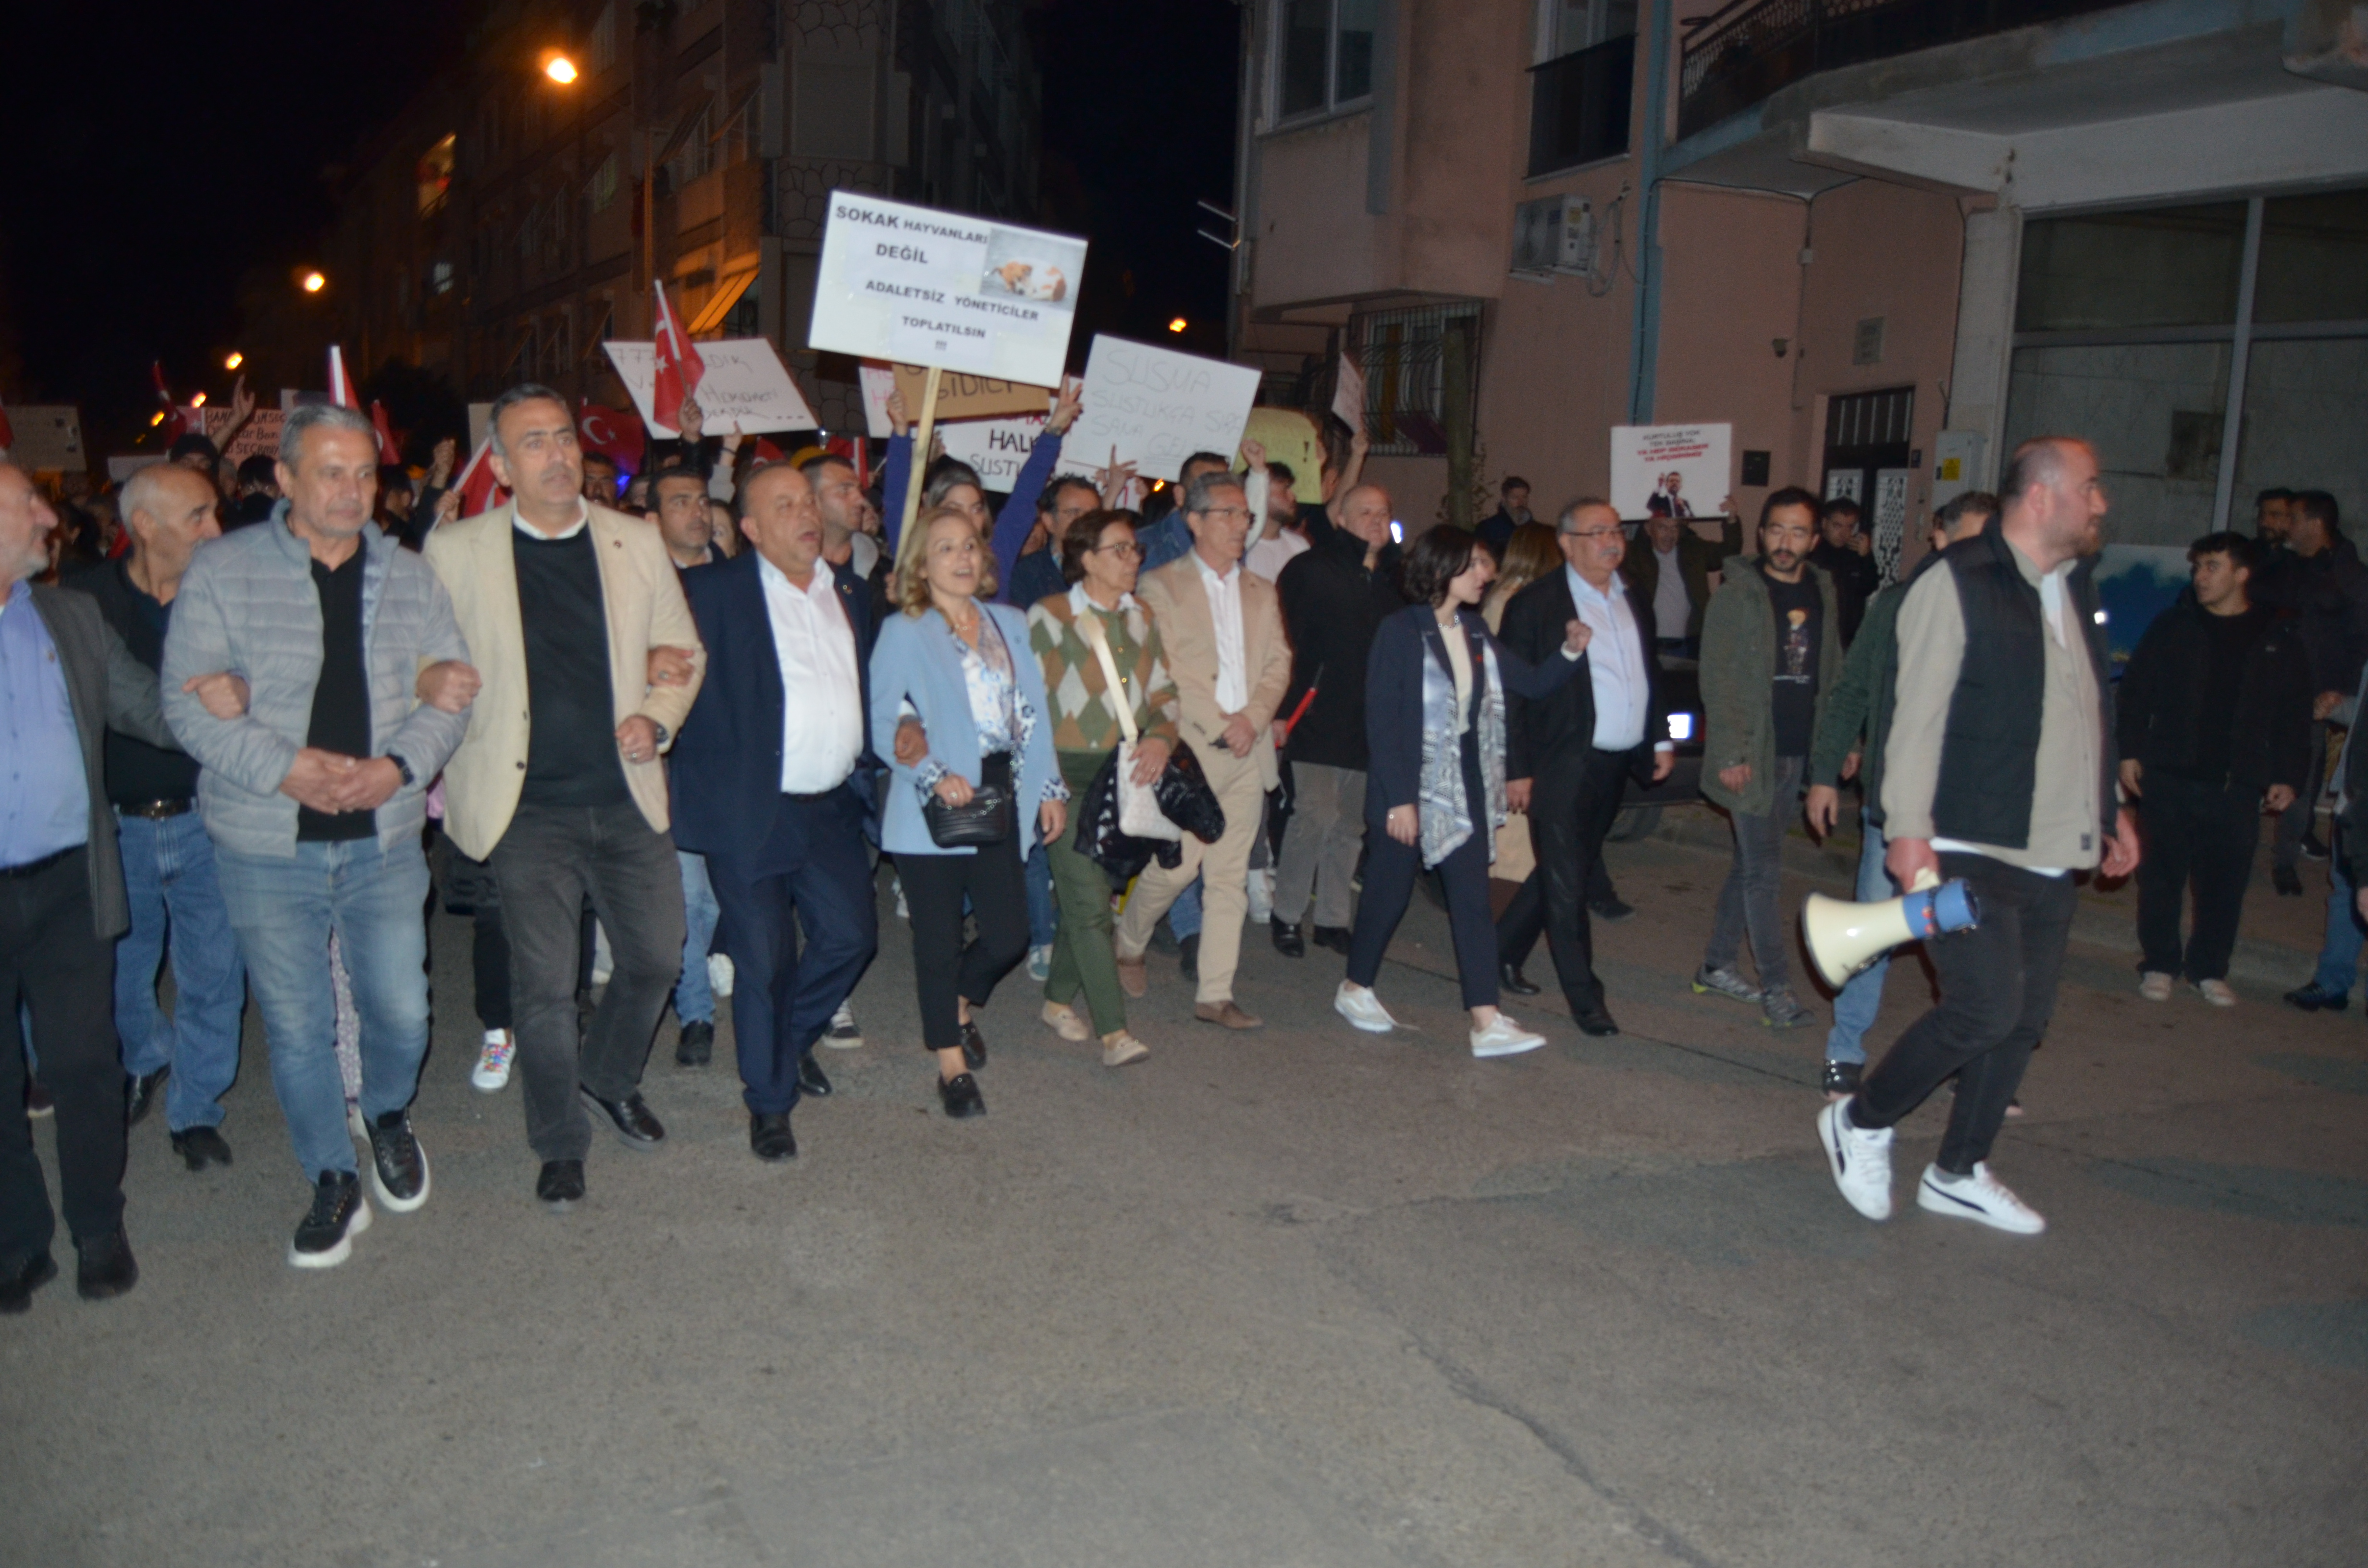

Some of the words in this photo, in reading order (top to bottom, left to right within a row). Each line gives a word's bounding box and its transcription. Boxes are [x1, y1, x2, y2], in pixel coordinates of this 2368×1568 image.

[836, 205, 899, 228] SOKAK
[903, 220, 988, 244] HAYVANLARI
[876, 243, 928, 264] DEĞİL
[865, 280, 945, 304] ADALETSİZ
[955, 296, 1039, 321] YÖNETİCİLER
[902, 316, 986, 338] TOPLATILSIN
[1102, 349, 1211, 394] SUSMA
